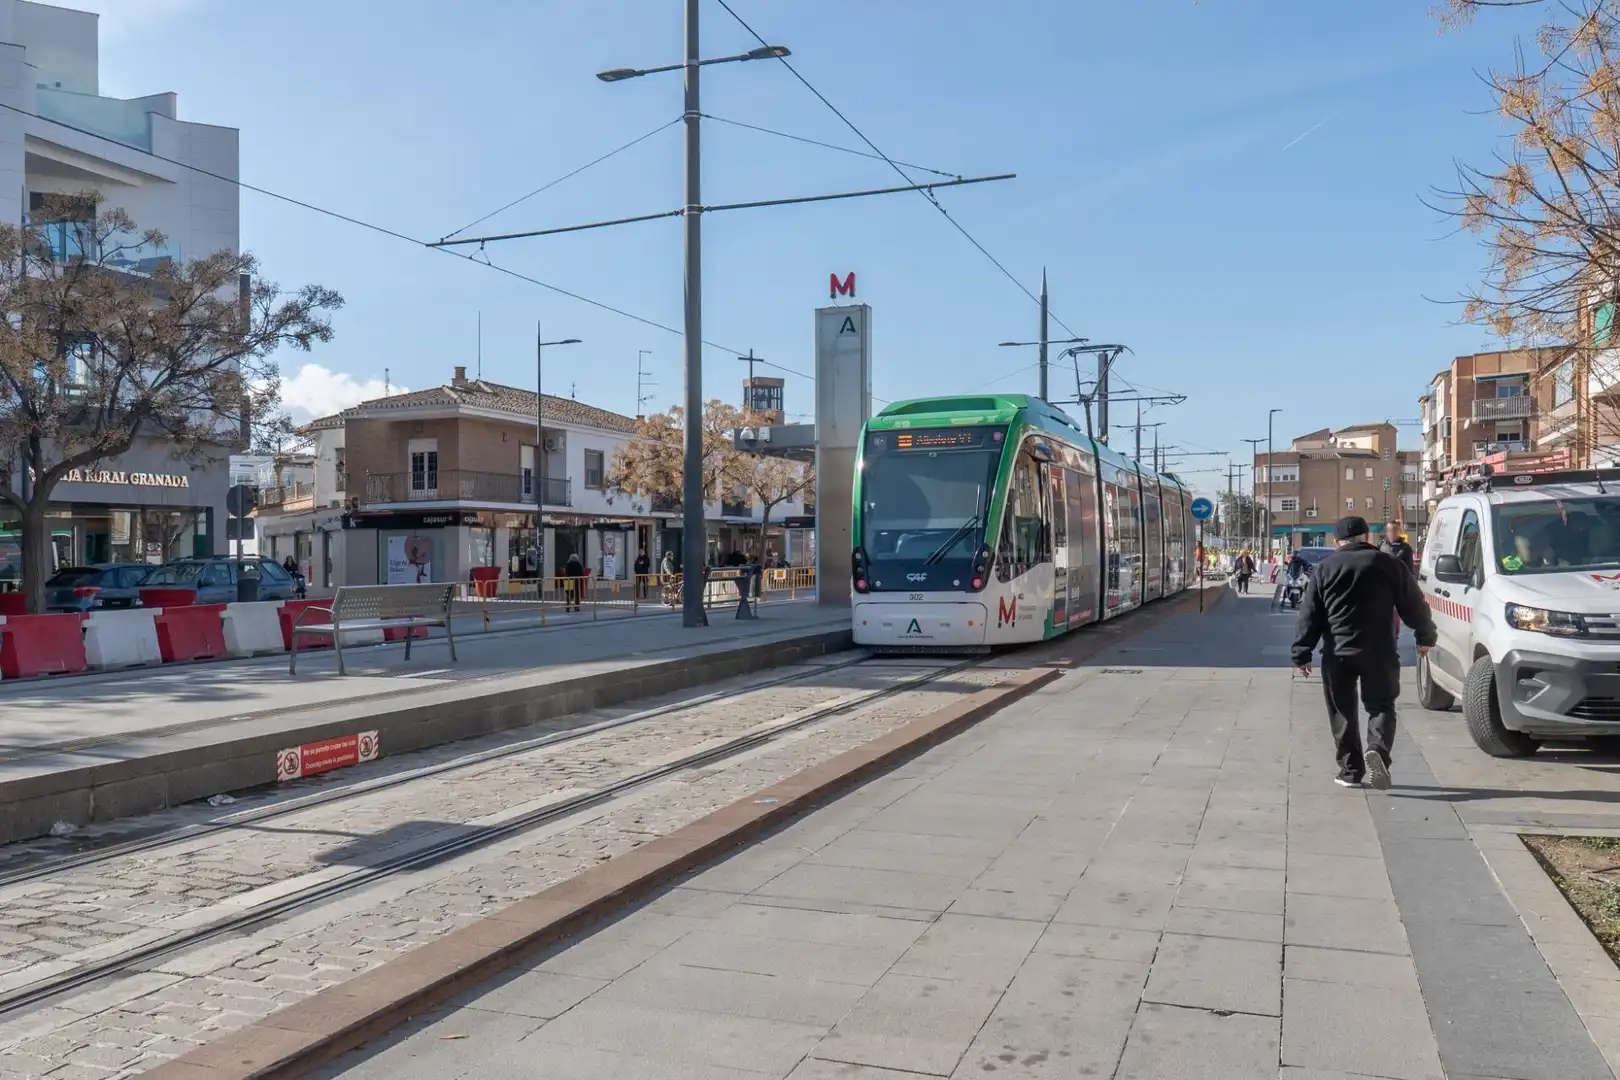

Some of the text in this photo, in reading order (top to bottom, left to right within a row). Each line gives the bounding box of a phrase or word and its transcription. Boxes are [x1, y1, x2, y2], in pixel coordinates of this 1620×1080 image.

[830, 271, 856, 299] M
[85, 469, 128, 484] RURAL
[131, 473, 189, 488] GRANADA
[423, 516, 448, 525] cajasur
[909, 593, 923, 601] 302
[998, 596, 1016, 628] M
